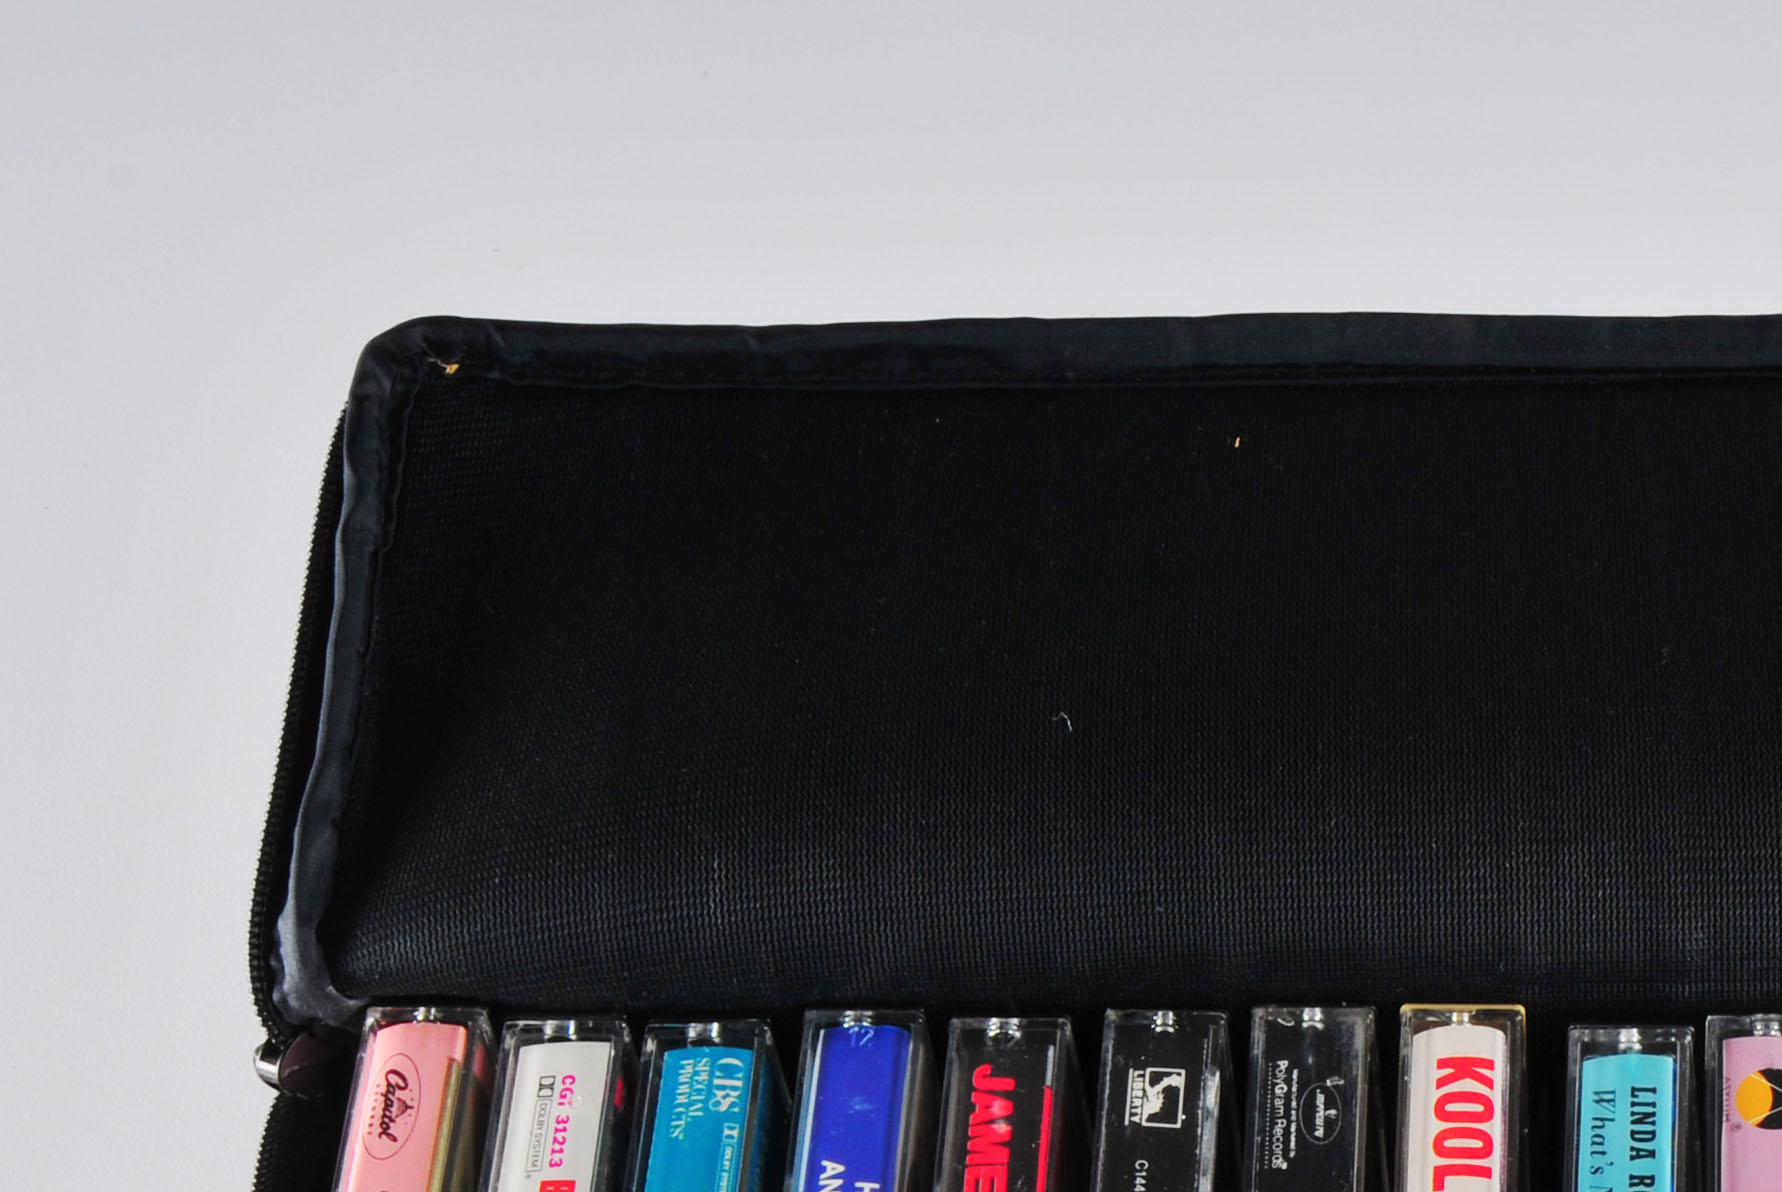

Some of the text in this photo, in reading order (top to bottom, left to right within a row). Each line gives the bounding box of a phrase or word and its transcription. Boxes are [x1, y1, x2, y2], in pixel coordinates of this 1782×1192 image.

[378, 1069, 409, 1143] Capitol
[670, 1060, 694, 1138] PRODUCTS
[709, 1057, 744, 1113] CBS
[1128, 1070, 1145, 1126] LIBERTY
[1271, 1059, 1289, 1169] PolyGram Records
[530, 1102, 549, 1168] DOLBY SYSTEM
[548, 1114, 571, 1168] 31213
[1432, 1056, 1495, 1192] KOOL
[1589, 1087, 1616, 1175] What's
[1629, 1086, 1657, 1161] LINDA
